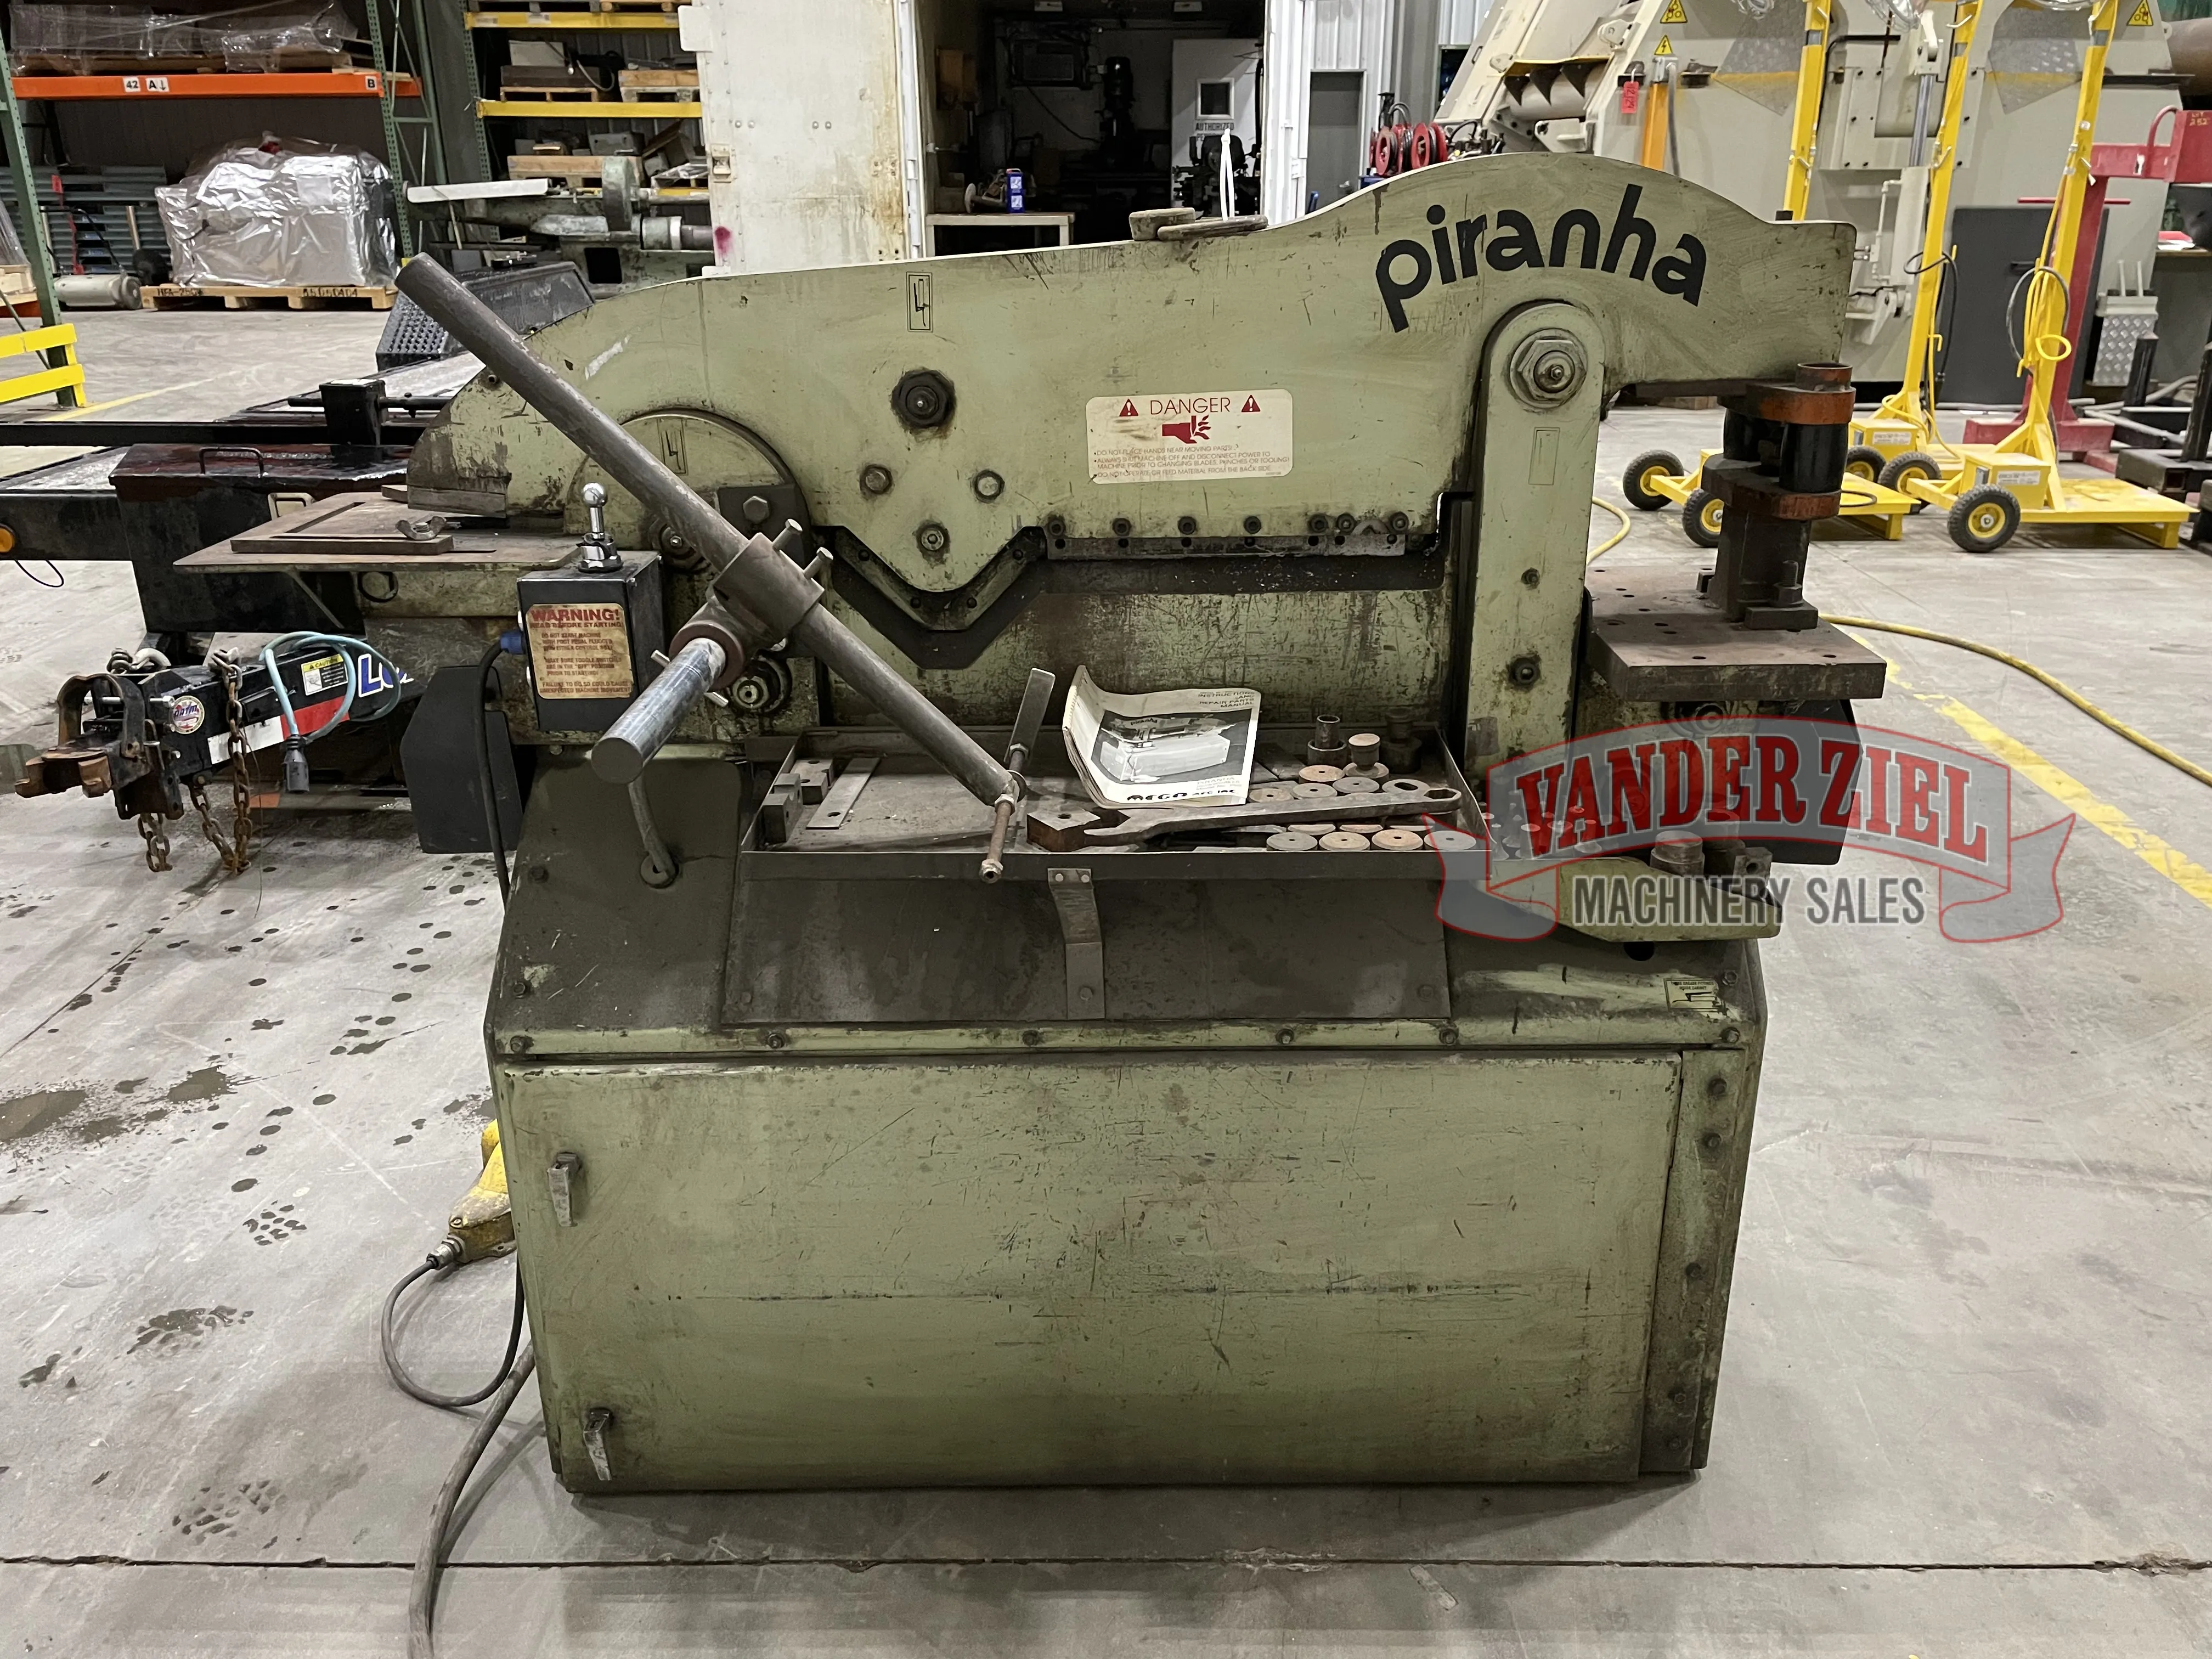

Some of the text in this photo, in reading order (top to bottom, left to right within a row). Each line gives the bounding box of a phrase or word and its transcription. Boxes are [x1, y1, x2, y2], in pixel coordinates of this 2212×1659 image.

[126, 80, 157, 89] 42 A
[368, 78, 375, 88] B
[1195, 122, 1234, 131] AUTHORIZED
[1376, 183, 1707, 333] piranha
[1150, 397, 1231, 415] DANGER
[531, 609, 620, 621] WARNING!
[315, 657, 338, 668] CAUTION
